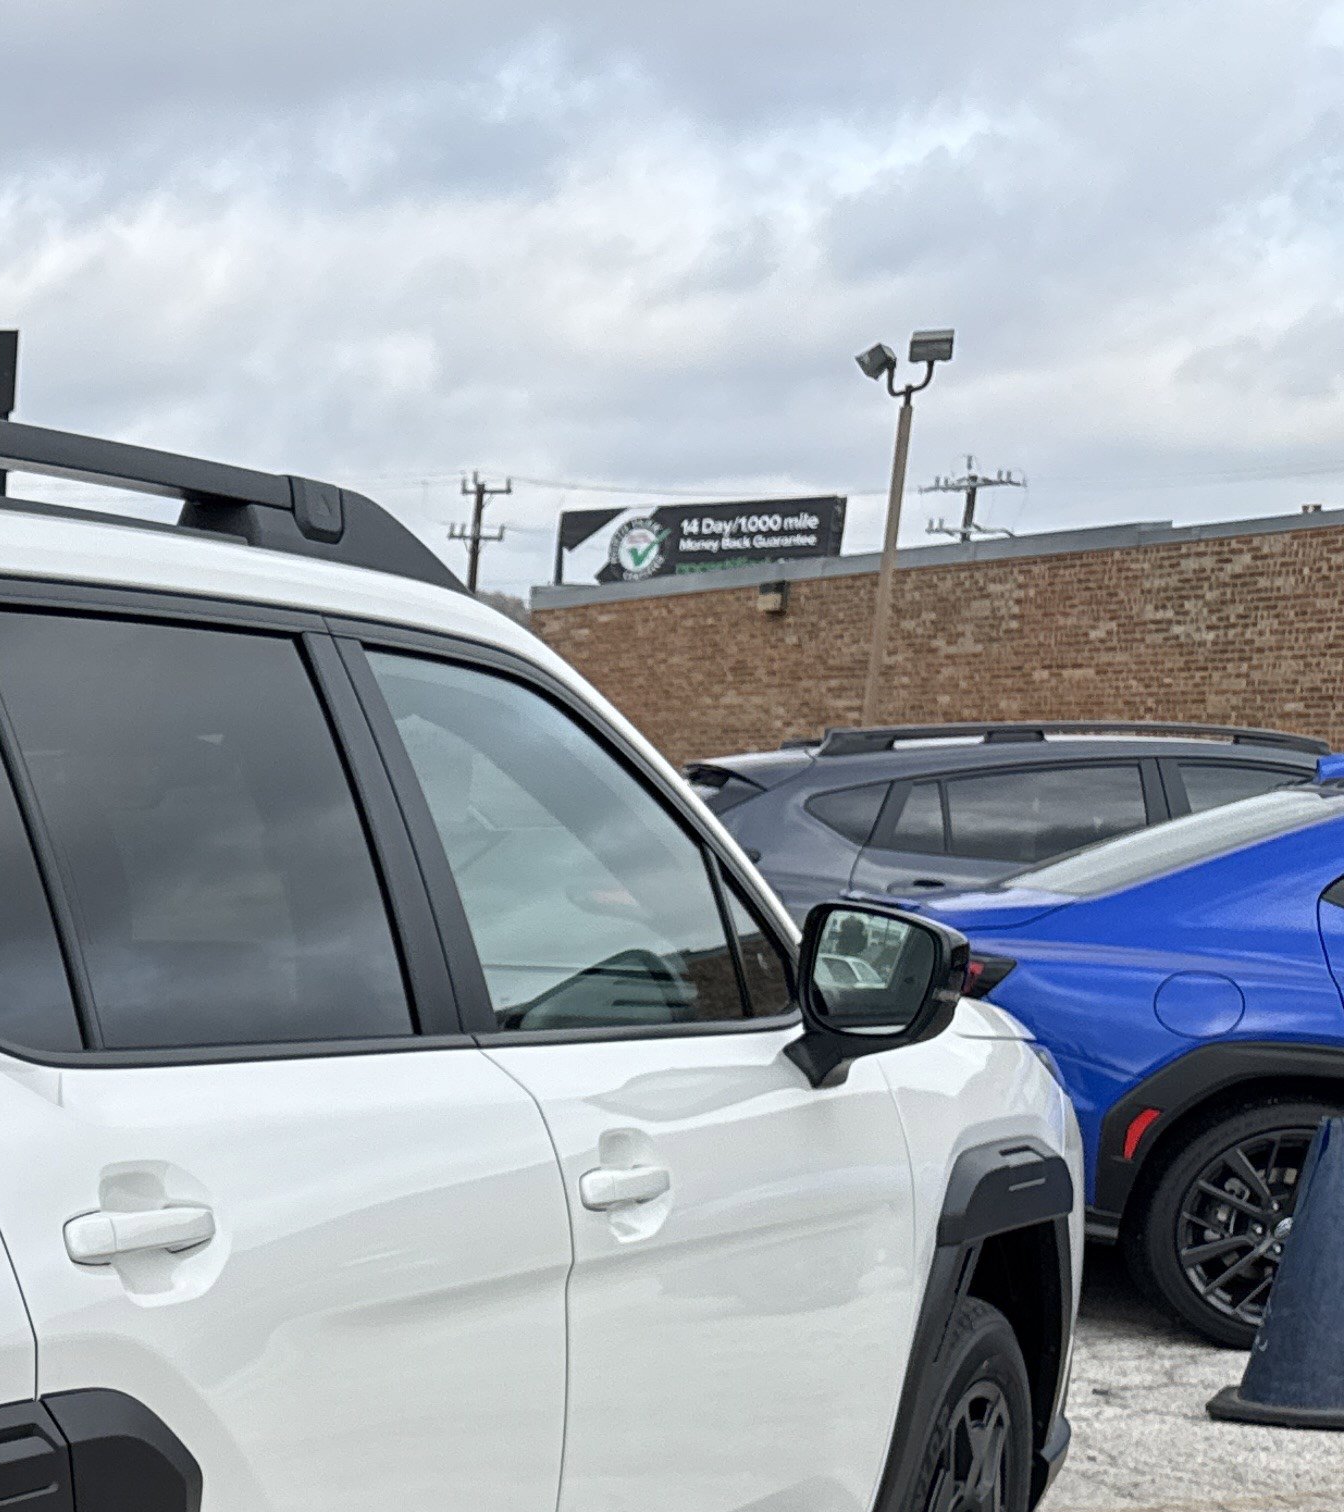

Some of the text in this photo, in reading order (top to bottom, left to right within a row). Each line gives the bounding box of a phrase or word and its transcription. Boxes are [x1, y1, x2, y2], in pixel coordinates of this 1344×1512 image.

[680, 518, 700, 536] 14
[783, 512, 820, 531] mile
[678, 534, 818, 553] Money Back Guarantee
